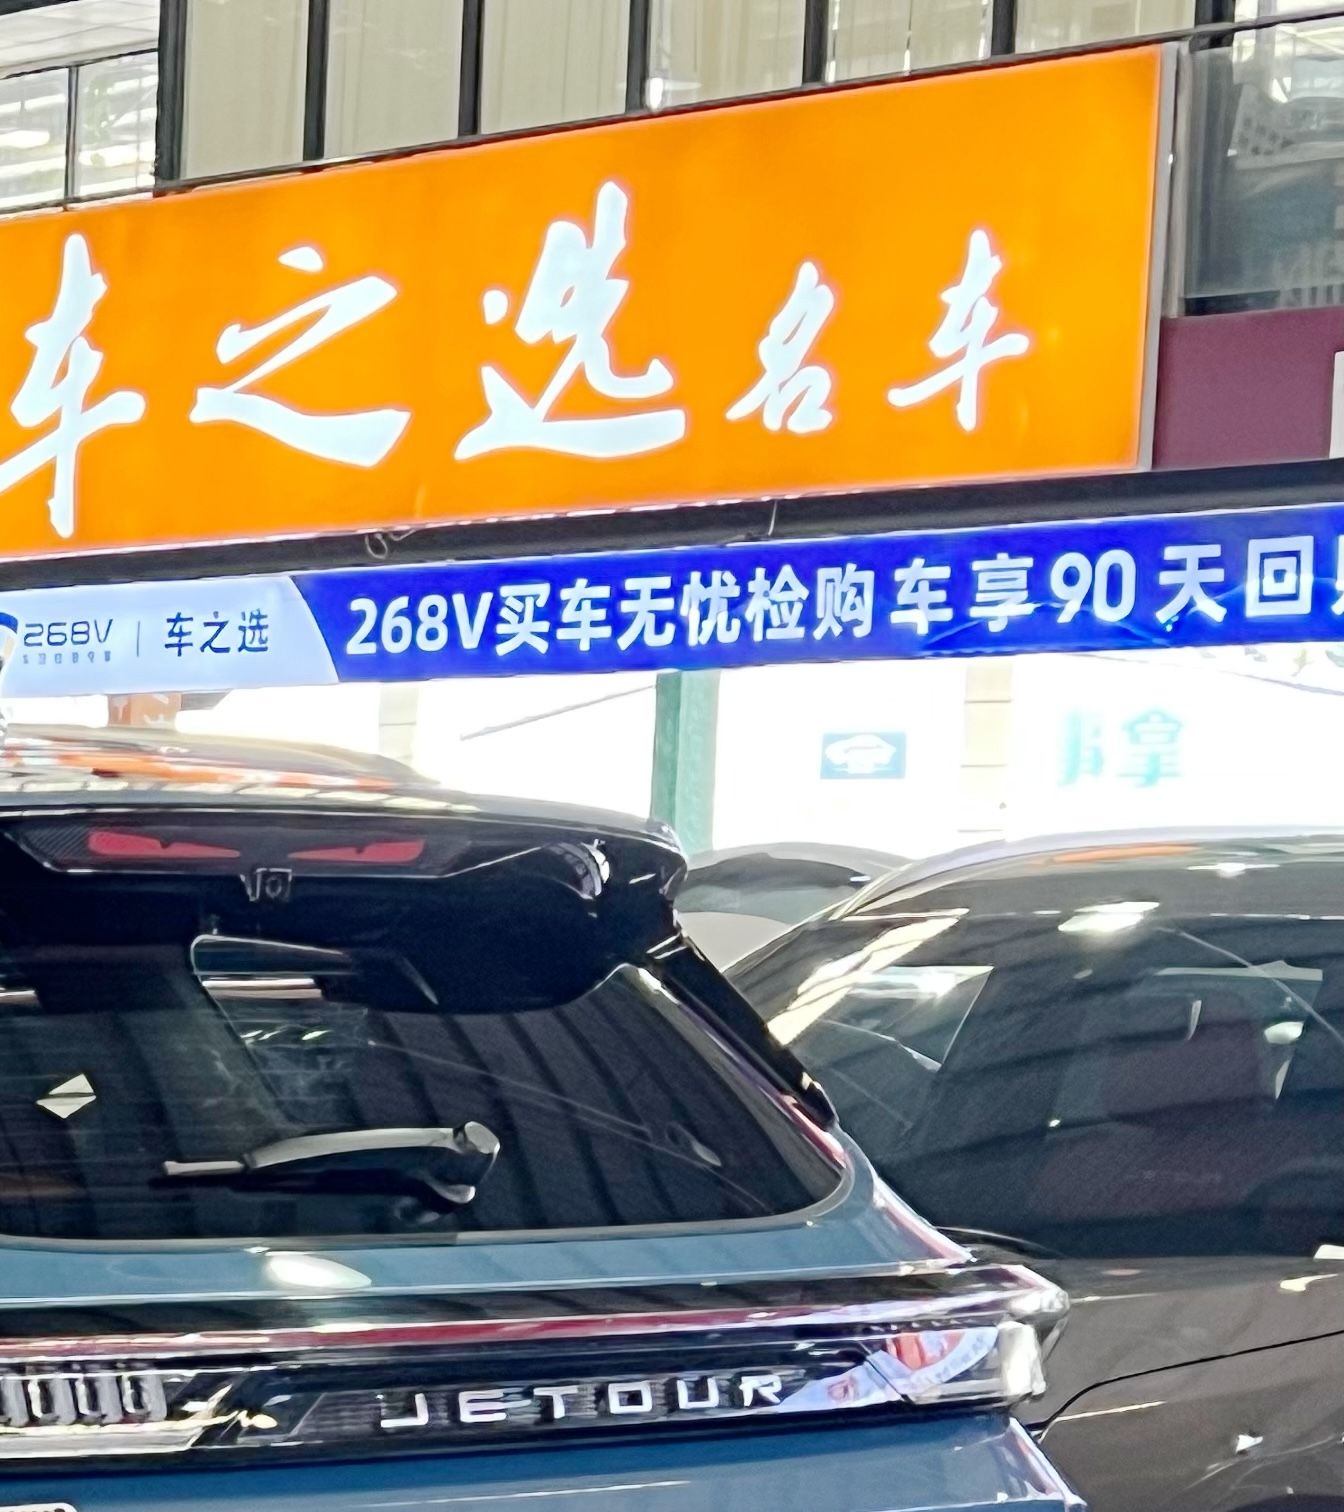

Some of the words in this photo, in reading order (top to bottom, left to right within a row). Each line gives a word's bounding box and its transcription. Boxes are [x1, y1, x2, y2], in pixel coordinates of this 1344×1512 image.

[23, 618, 114, 647] 268V
[164, 607, 270, 657] 车之选
[379, 1374, 782, 1429] JETOUR
